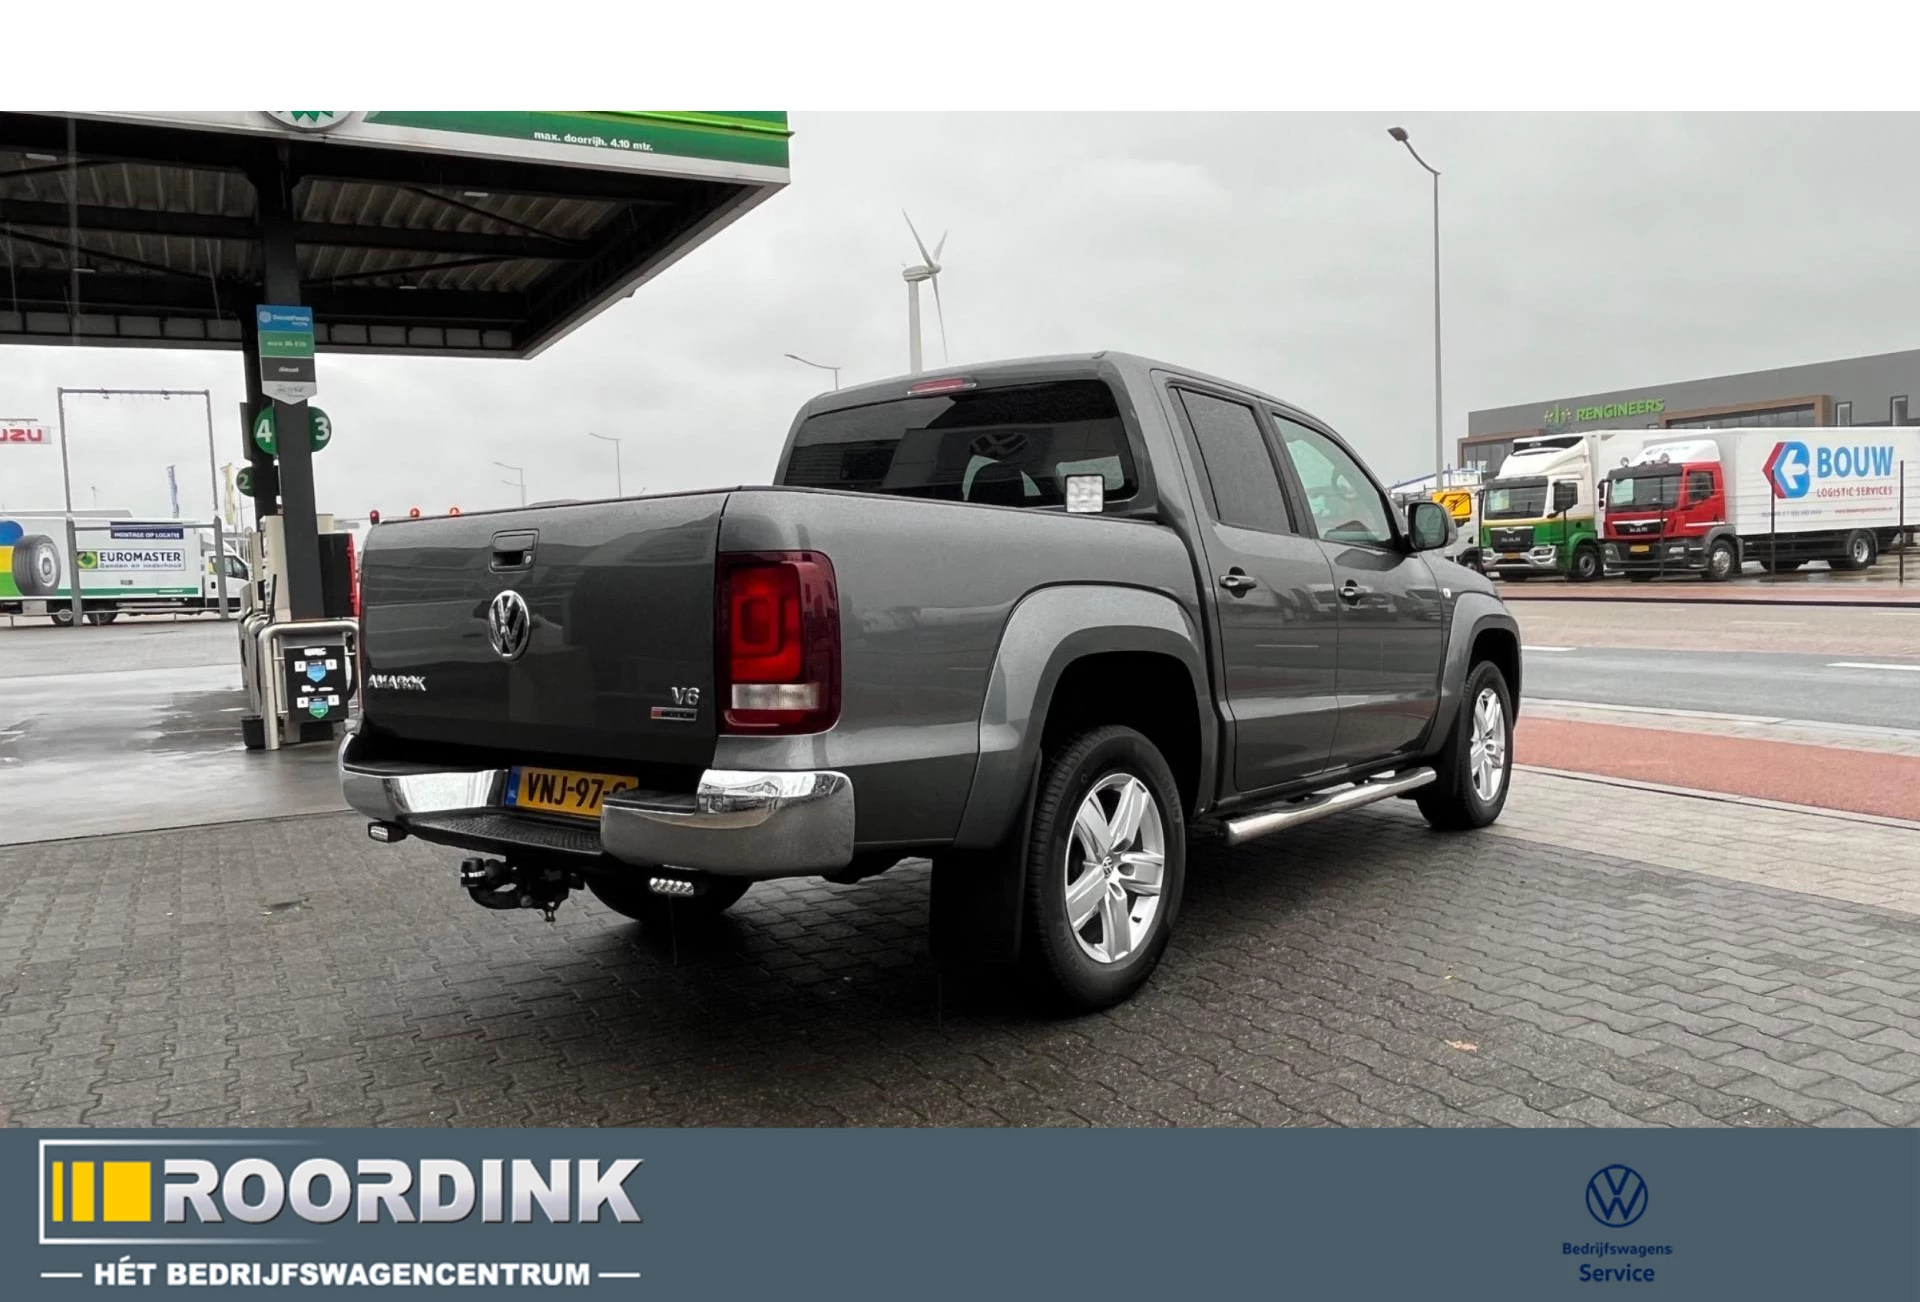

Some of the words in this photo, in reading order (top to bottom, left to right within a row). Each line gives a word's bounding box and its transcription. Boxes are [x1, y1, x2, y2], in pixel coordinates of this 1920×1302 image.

[534, 131, 560, 141] max.
[564, 133, 607, 147] doorrijh.
[610, 138, 630, 149] 4.10
[633, 142, 653, 151] mtr.
[1576, 399, 1665, 421] RENGINEERS
[256, 419, 272, 443] 4
[315, 417, 330, 440] 3
[1817, 446, 1893, 478] BOUW
[238, 474, 251, 490] 2
[1816, 487, 1854, 498] LOGISTIC
[1856, 486, 1893, 496] SERVICES
[100, 552, 181, 562] EUROMASTER
[671, 686, 700, 705] V6
